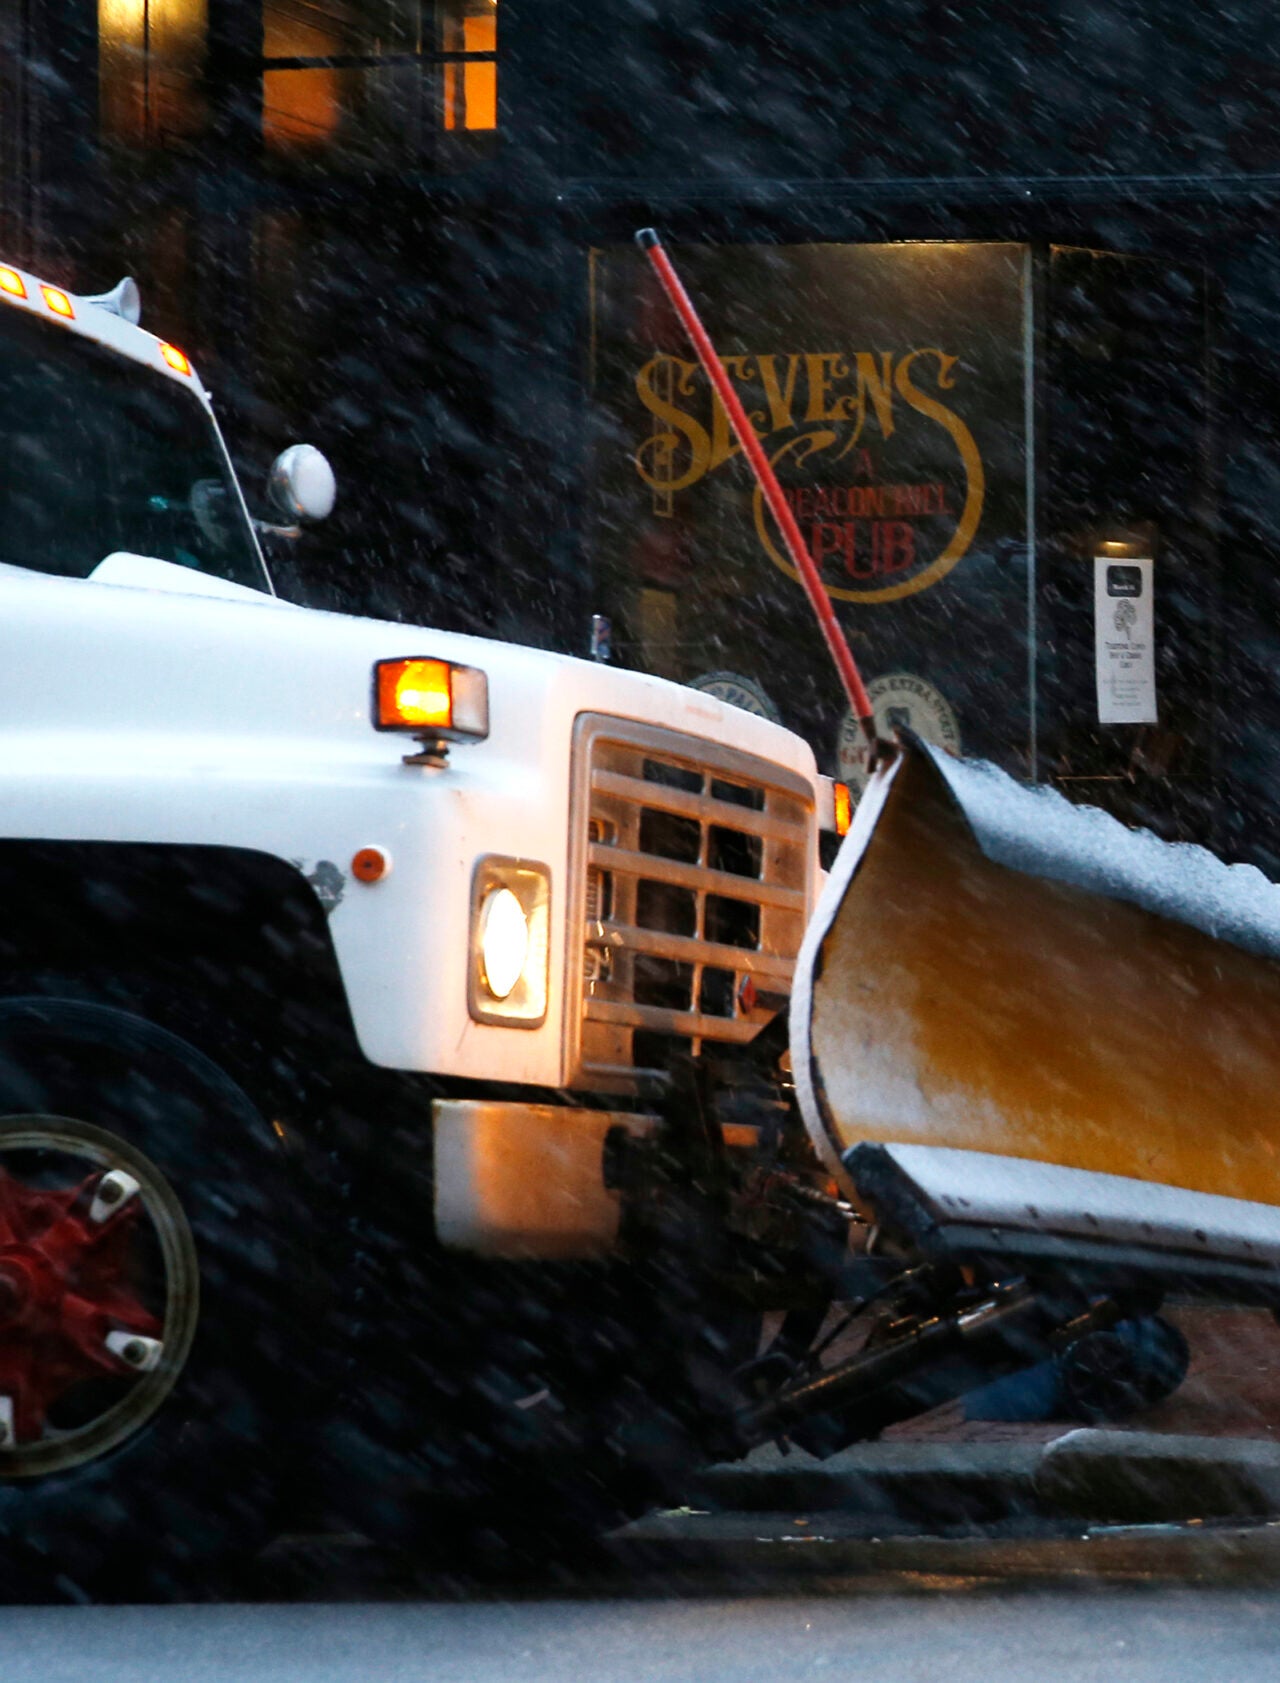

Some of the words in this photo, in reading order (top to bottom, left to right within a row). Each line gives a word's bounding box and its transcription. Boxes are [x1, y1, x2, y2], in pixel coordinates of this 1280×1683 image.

[635, 347, 985, 604] SEVENS
[855, 447, 876, 479] A
[784, 485, 887, 518] EACON
[811, 520, 916, 580] PUB
